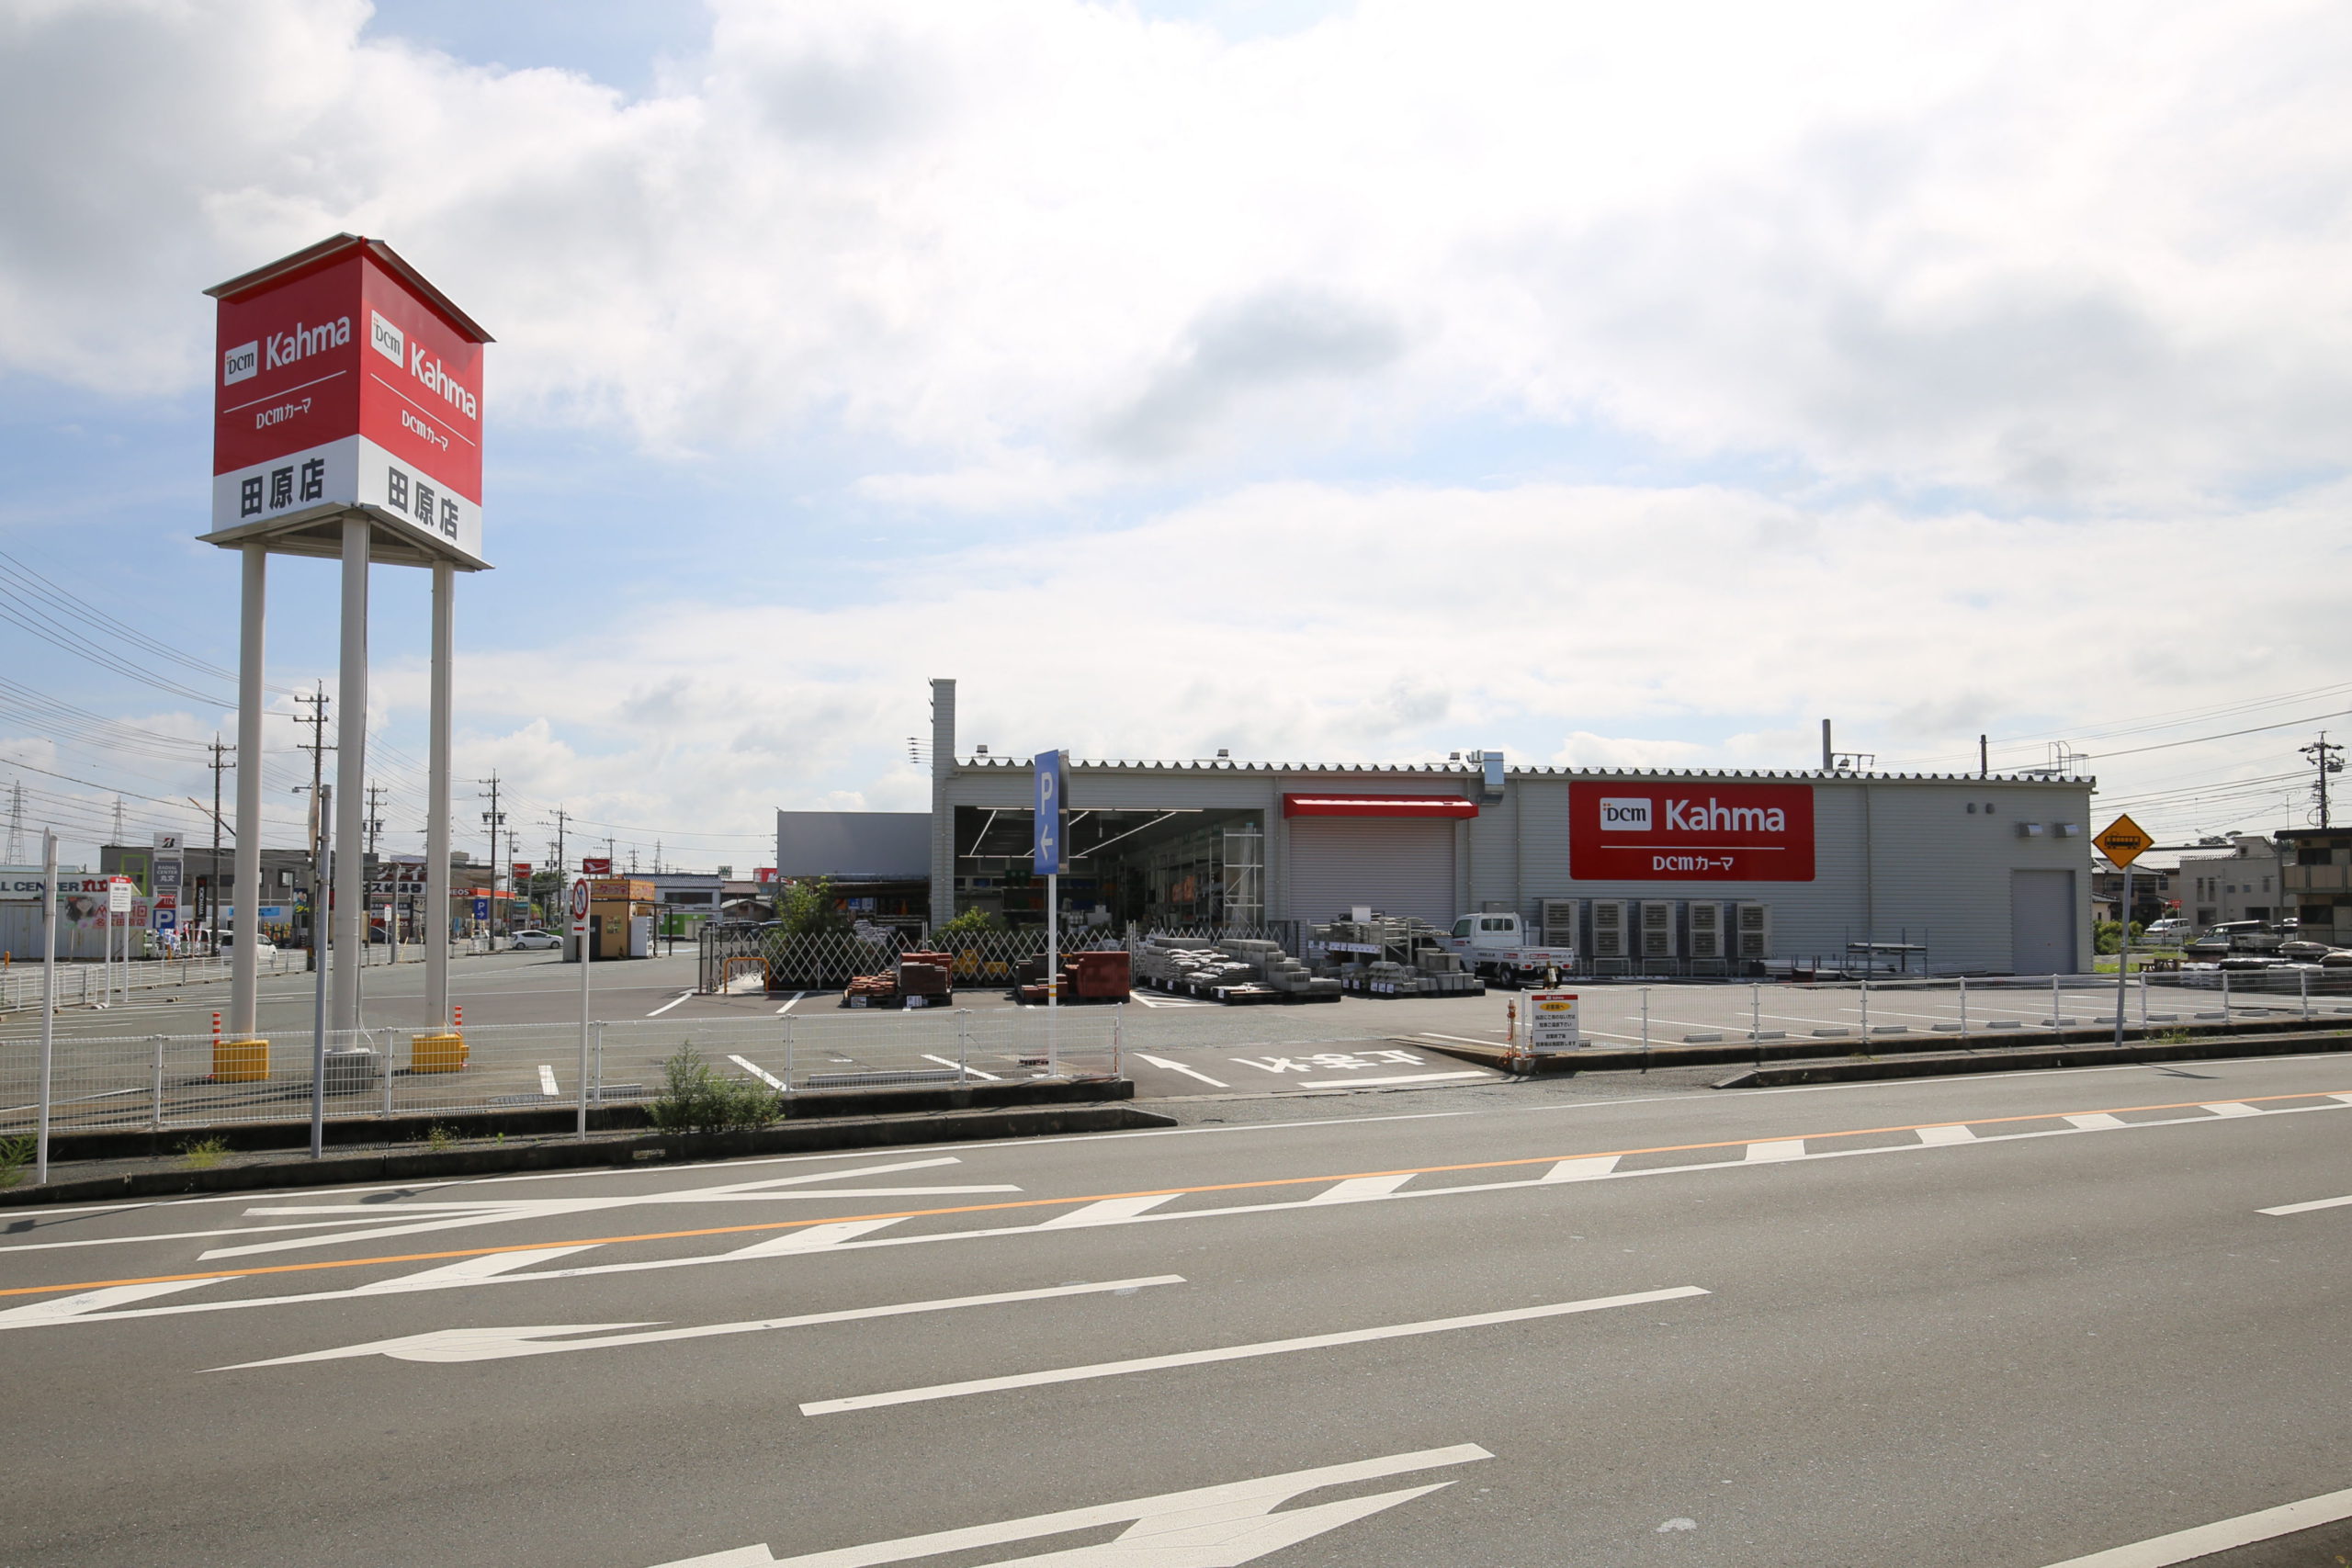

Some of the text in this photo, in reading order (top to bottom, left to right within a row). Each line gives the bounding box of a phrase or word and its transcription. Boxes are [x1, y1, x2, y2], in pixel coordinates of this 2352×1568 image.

[266, 316, 351, 371] Kahma
[411, 342, 477, 421] Kahma
[241, 457, 324, 518] 田原店
[388, 466, 458, 540] 田原店
[1041, 772, 1053, 816] P
[1665, 797, 1785, 832] Kahma
[155, 910, 174, 929] P
[478, 901, 485, 910] P
[1227, 1049, 1427, 1074] 止まれ
